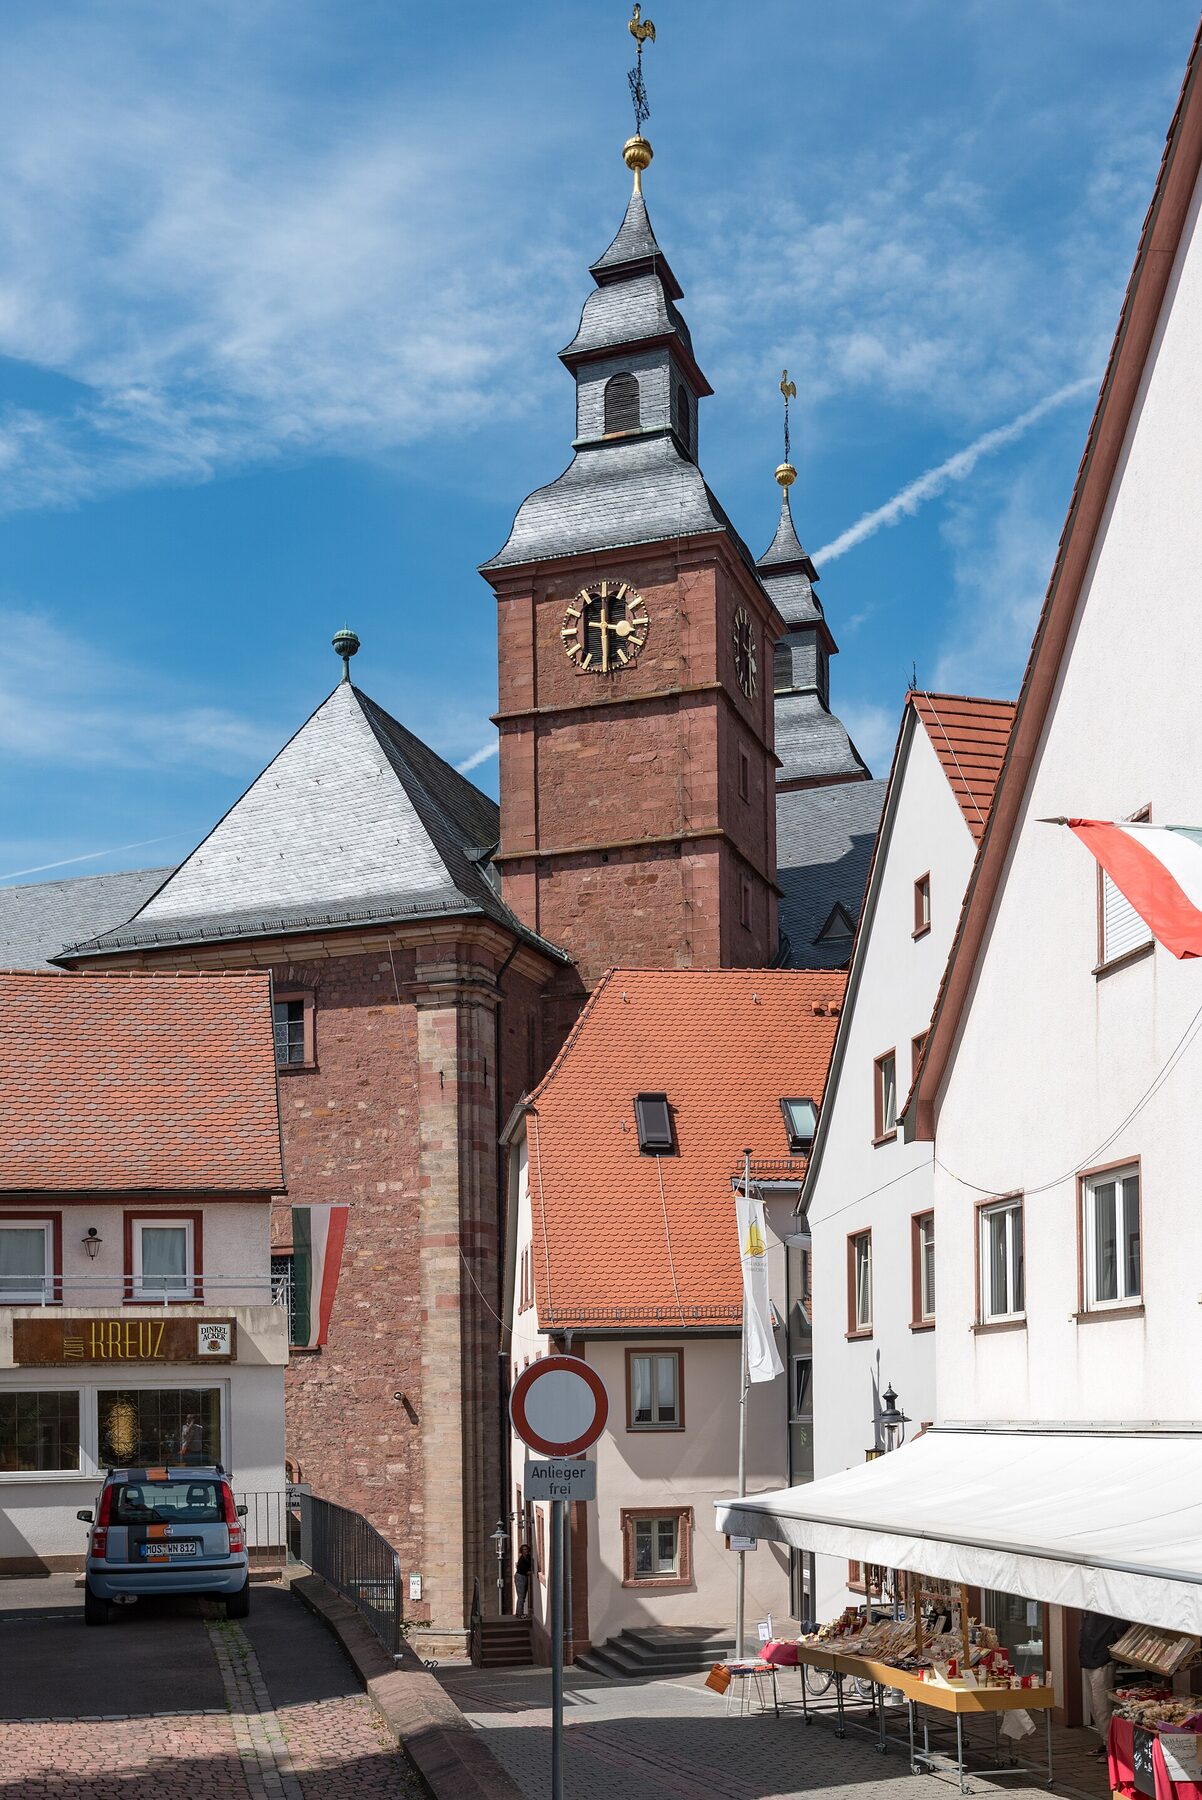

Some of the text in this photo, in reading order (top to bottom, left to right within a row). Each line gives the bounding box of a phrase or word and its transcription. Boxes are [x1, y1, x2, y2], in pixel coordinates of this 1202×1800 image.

[201, 1325, 228, 1335] DINKEL
[89, 1322, 165, 1358] KREUZ
[202, 1333, 227, 1341] ACKER
[531, 1465, 586, 1481] Anlieger
[549, 1482, 571, 1495] frei
[146, 1543, 195, 1554] MOS WN 812
